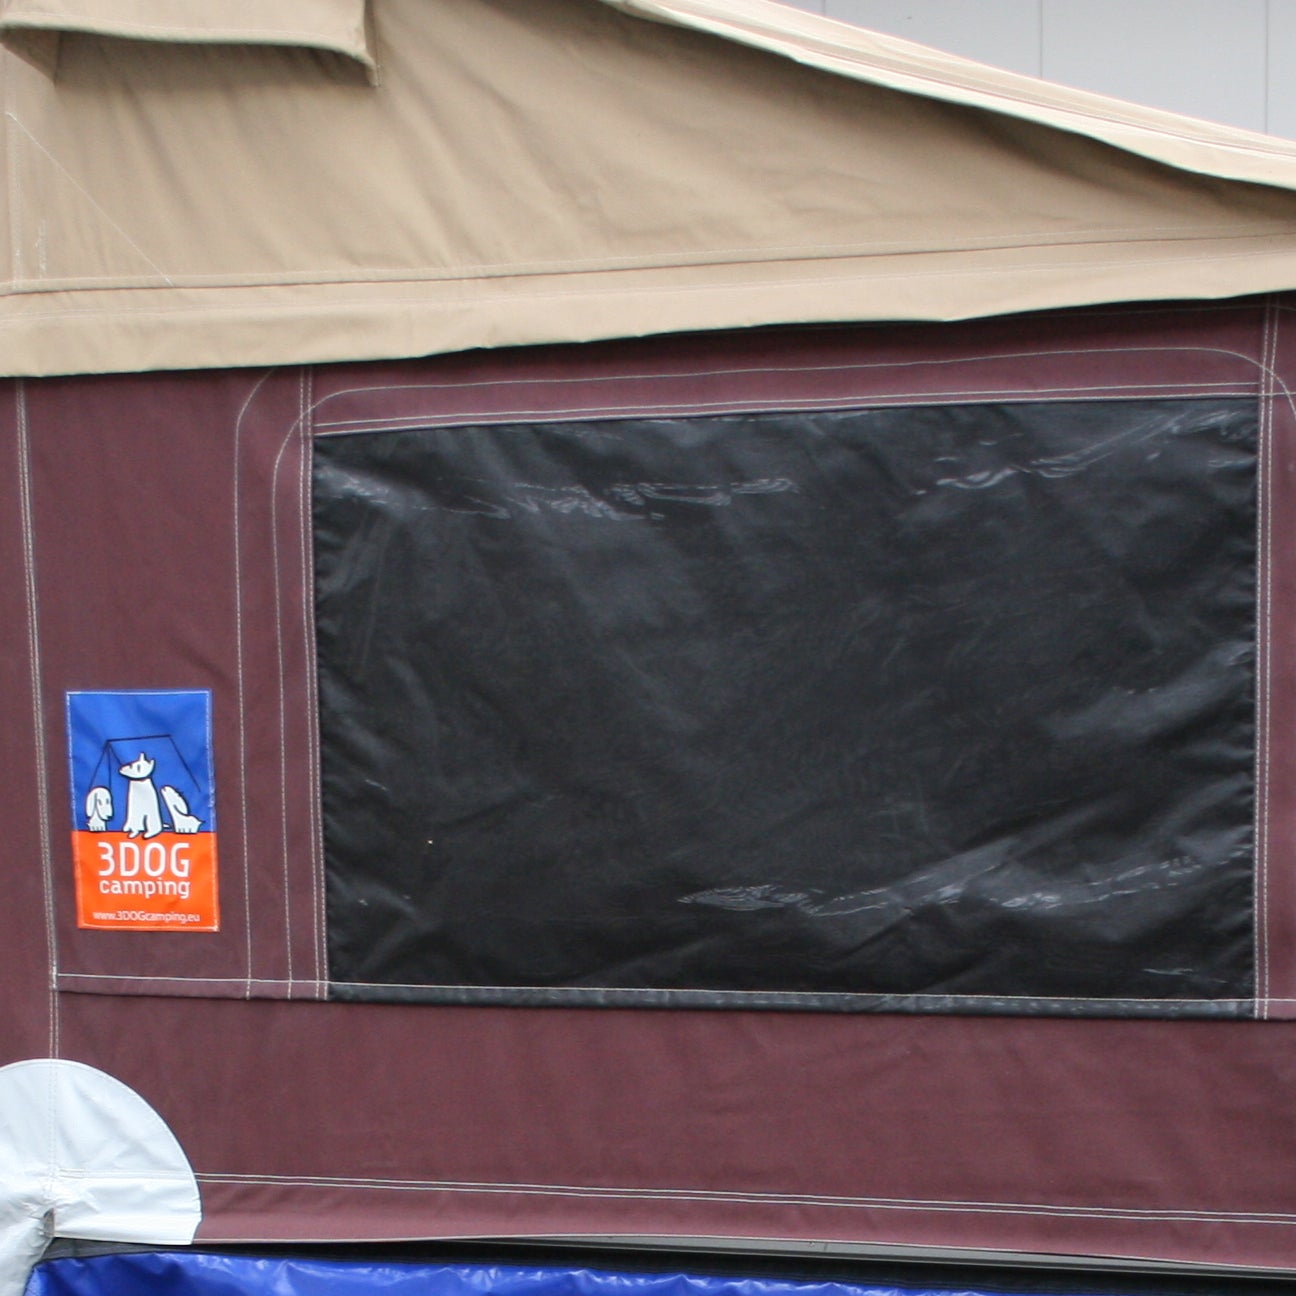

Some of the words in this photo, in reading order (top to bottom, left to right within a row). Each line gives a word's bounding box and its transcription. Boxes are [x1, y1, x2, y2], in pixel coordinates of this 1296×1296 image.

[97, 842, 190, 877] 3DOG
[99, 877, 191, 899] camping
[92, 910, 200, 924] www.3DOGcamping.eu
